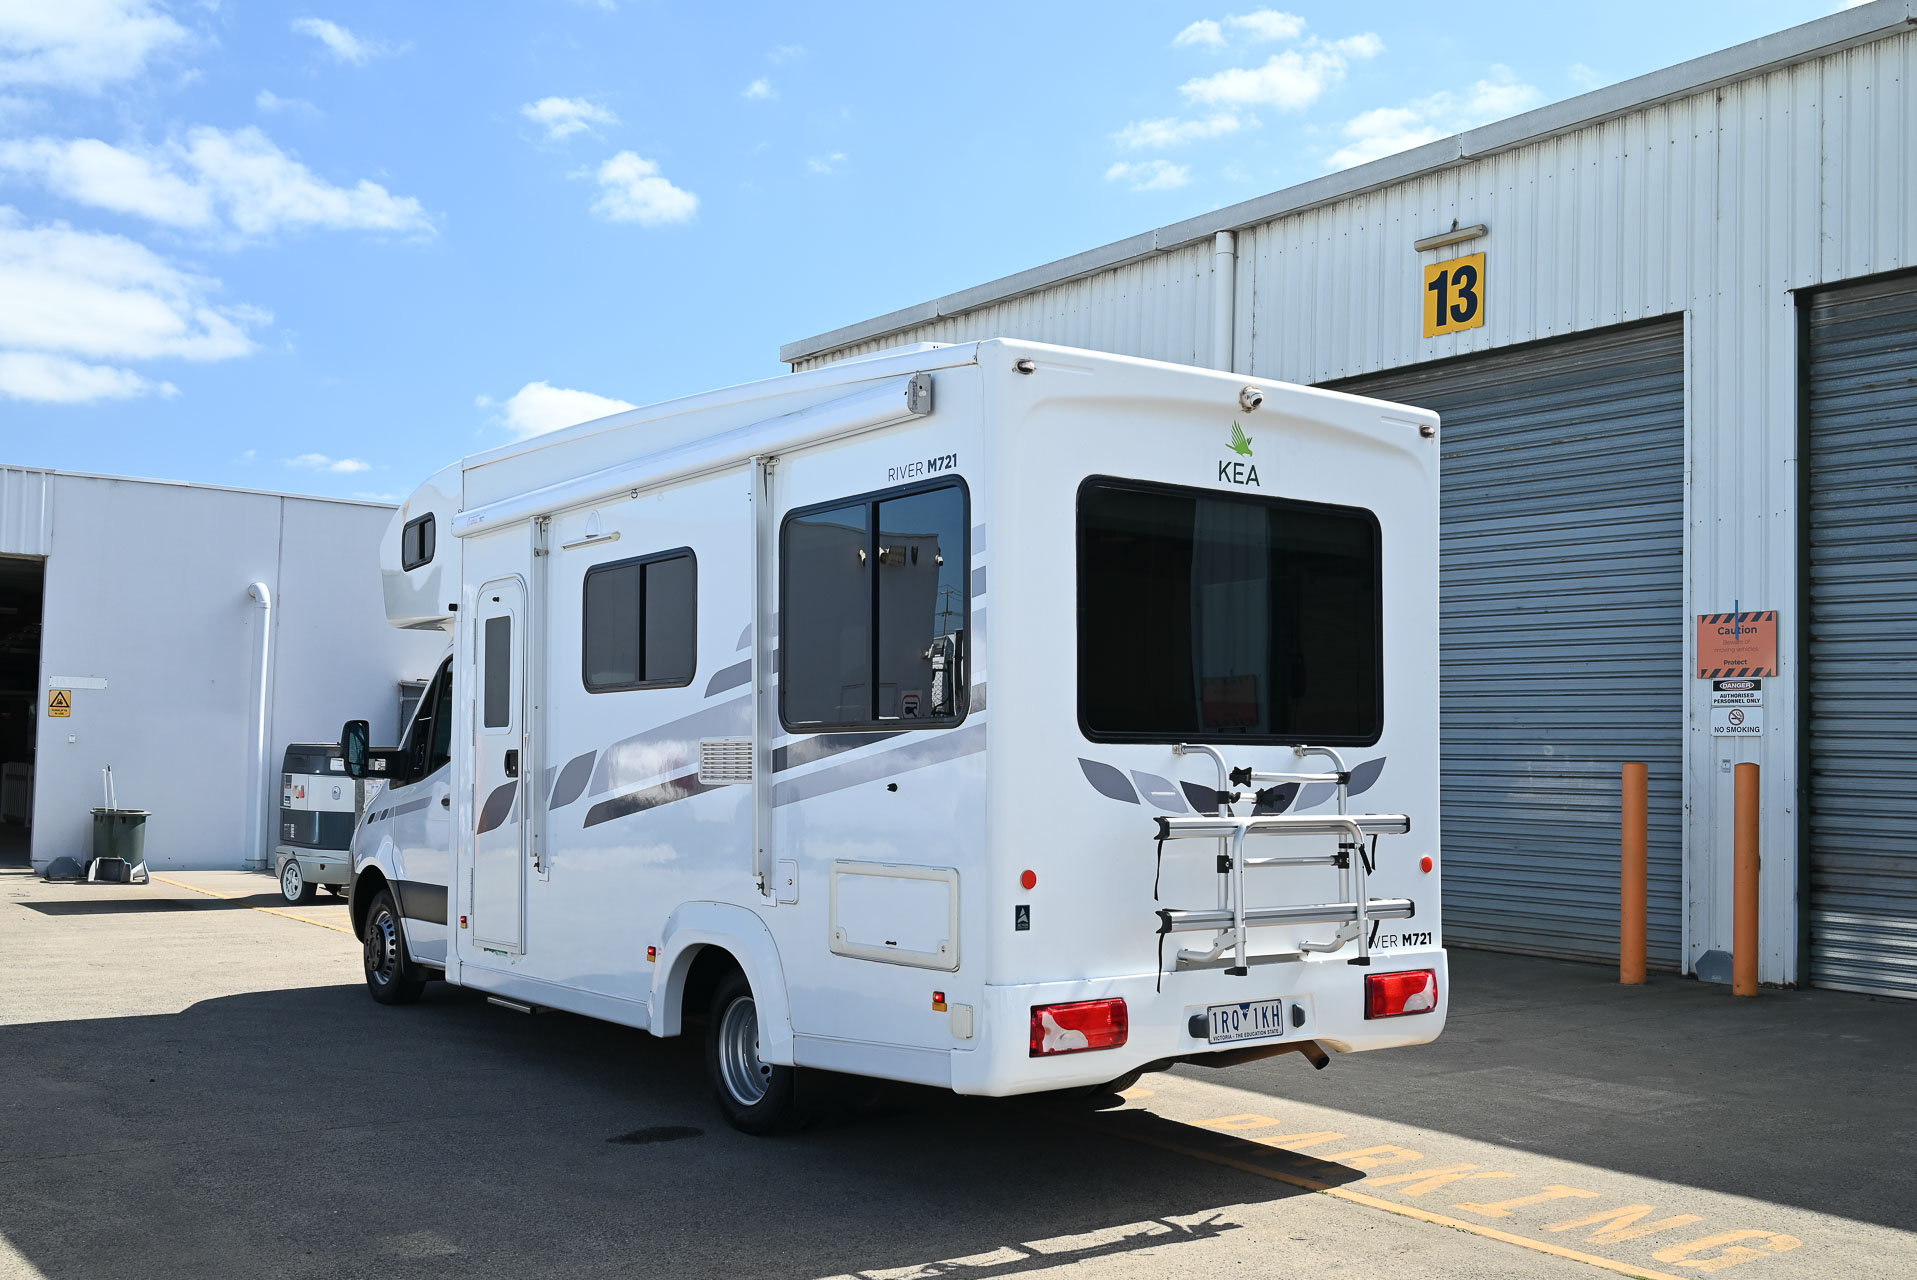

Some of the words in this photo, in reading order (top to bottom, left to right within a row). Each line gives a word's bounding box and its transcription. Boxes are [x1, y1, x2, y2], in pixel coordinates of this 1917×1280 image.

[1428, 265, 1478, 327] 13
[888, 461, 924, 482] RIVER
[927, 453, 957, 473] M721
[1218, 460, 1260, 487] KEA
[1371, 934, 1398, 948] VER
[1402, 932, 1432, 946] M721
[1213, 1009, 1239, 1034] 1RQ
[1253, 1005, 1279, 1029] 1KH
[1186, 1113, 1804, 1272] PARKING
